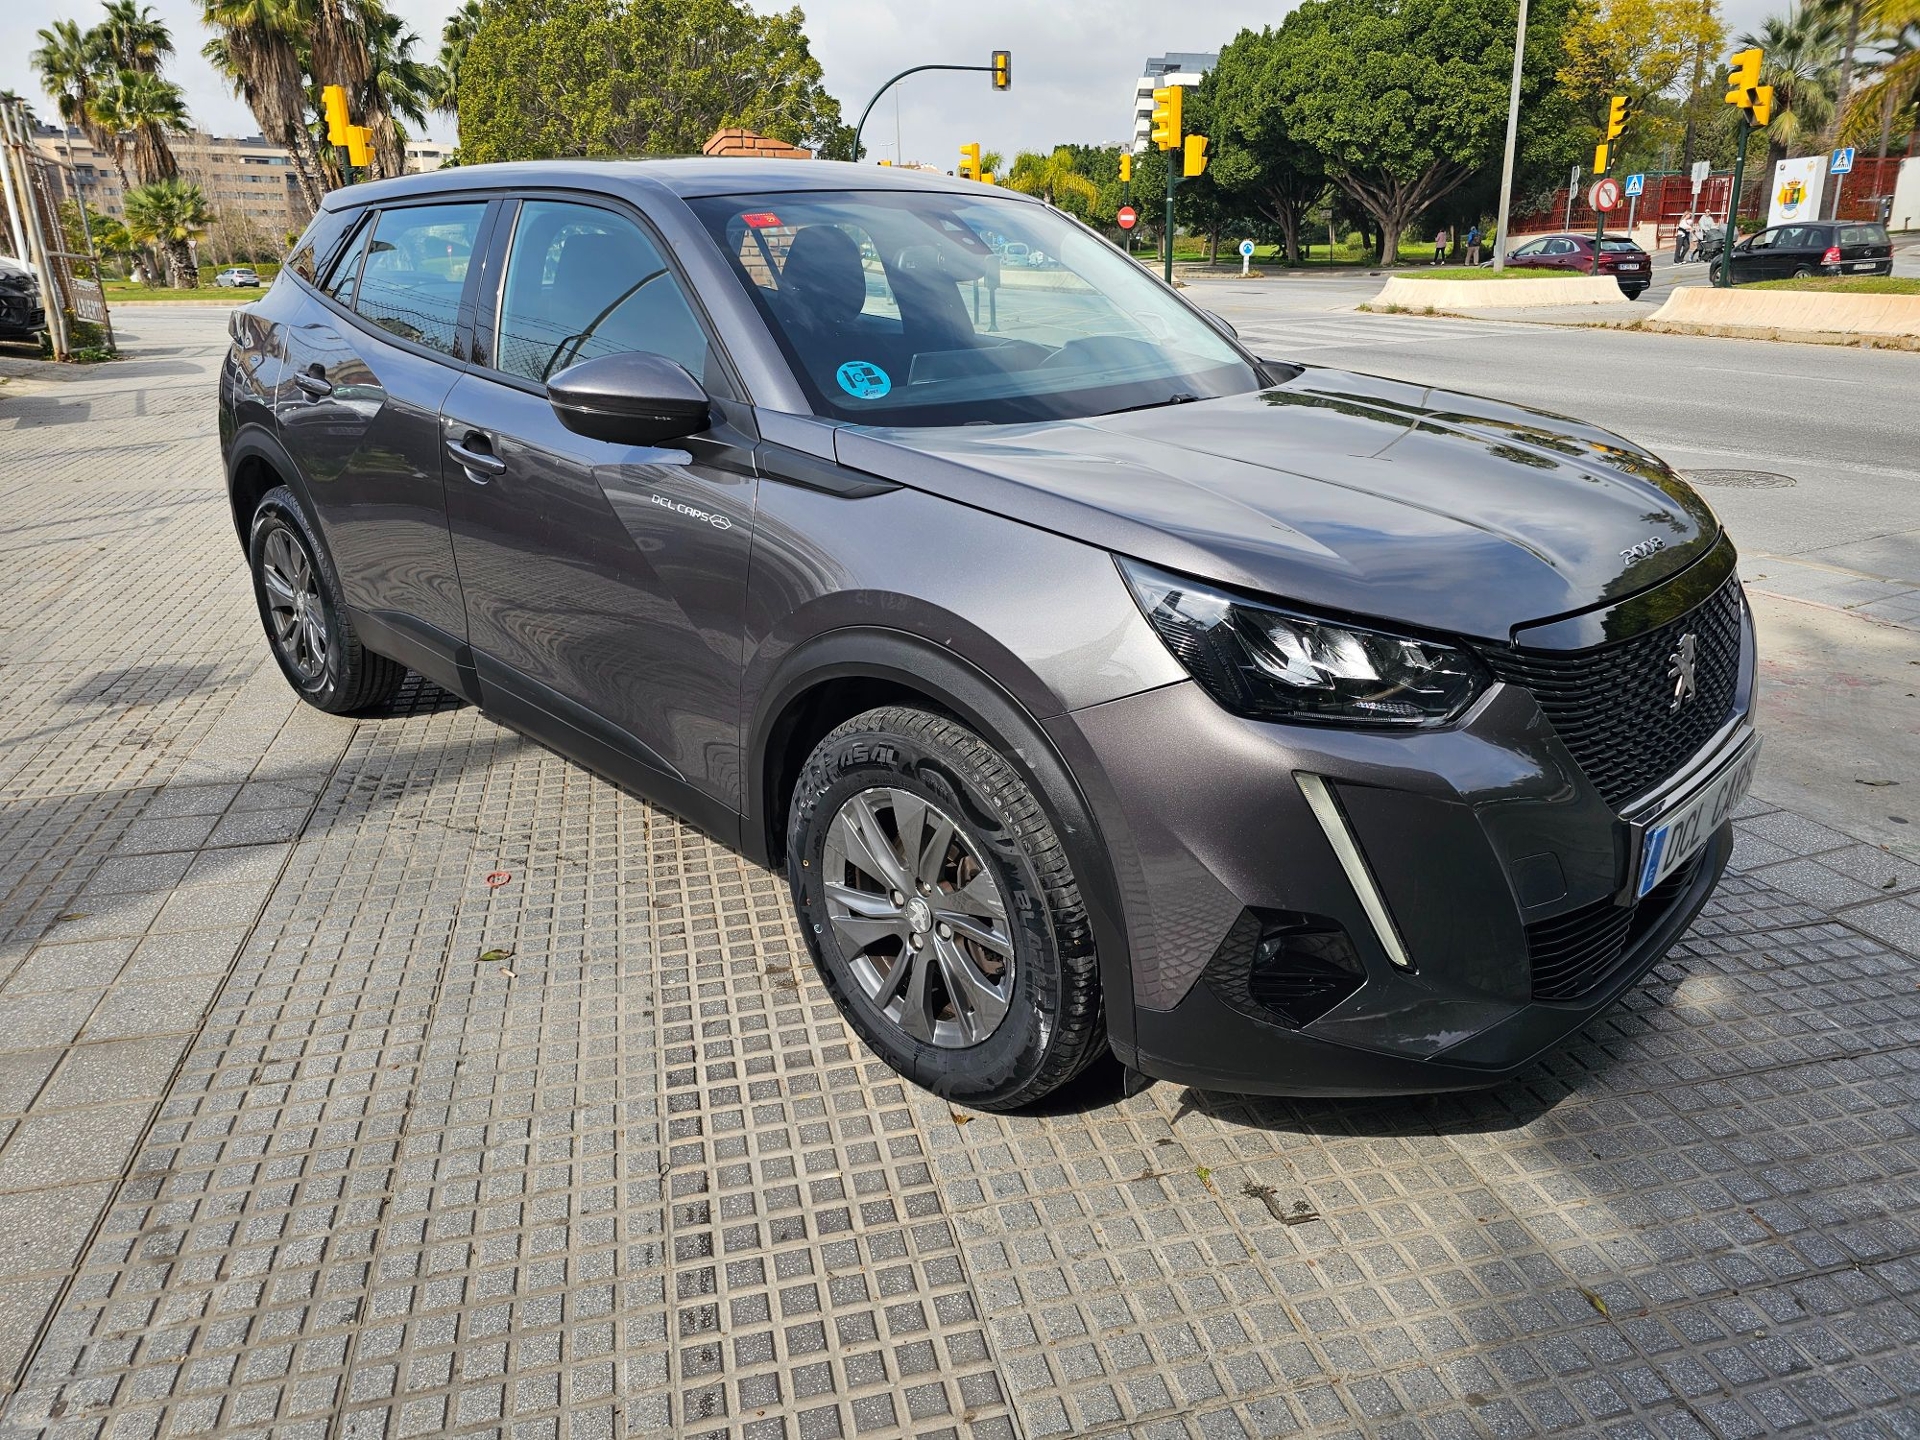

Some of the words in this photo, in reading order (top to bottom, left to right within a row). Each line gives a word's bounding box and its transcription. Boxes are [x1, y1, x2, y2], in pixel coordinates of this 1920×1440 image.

[651, 493, 676, 511] DCL
[676, 503, 710, 522] CARS
[1619, 536, 1666, 566] 2008
[1662, 802, 1705, 873] DCL
[1711, 750, 1757, 827] CARS
